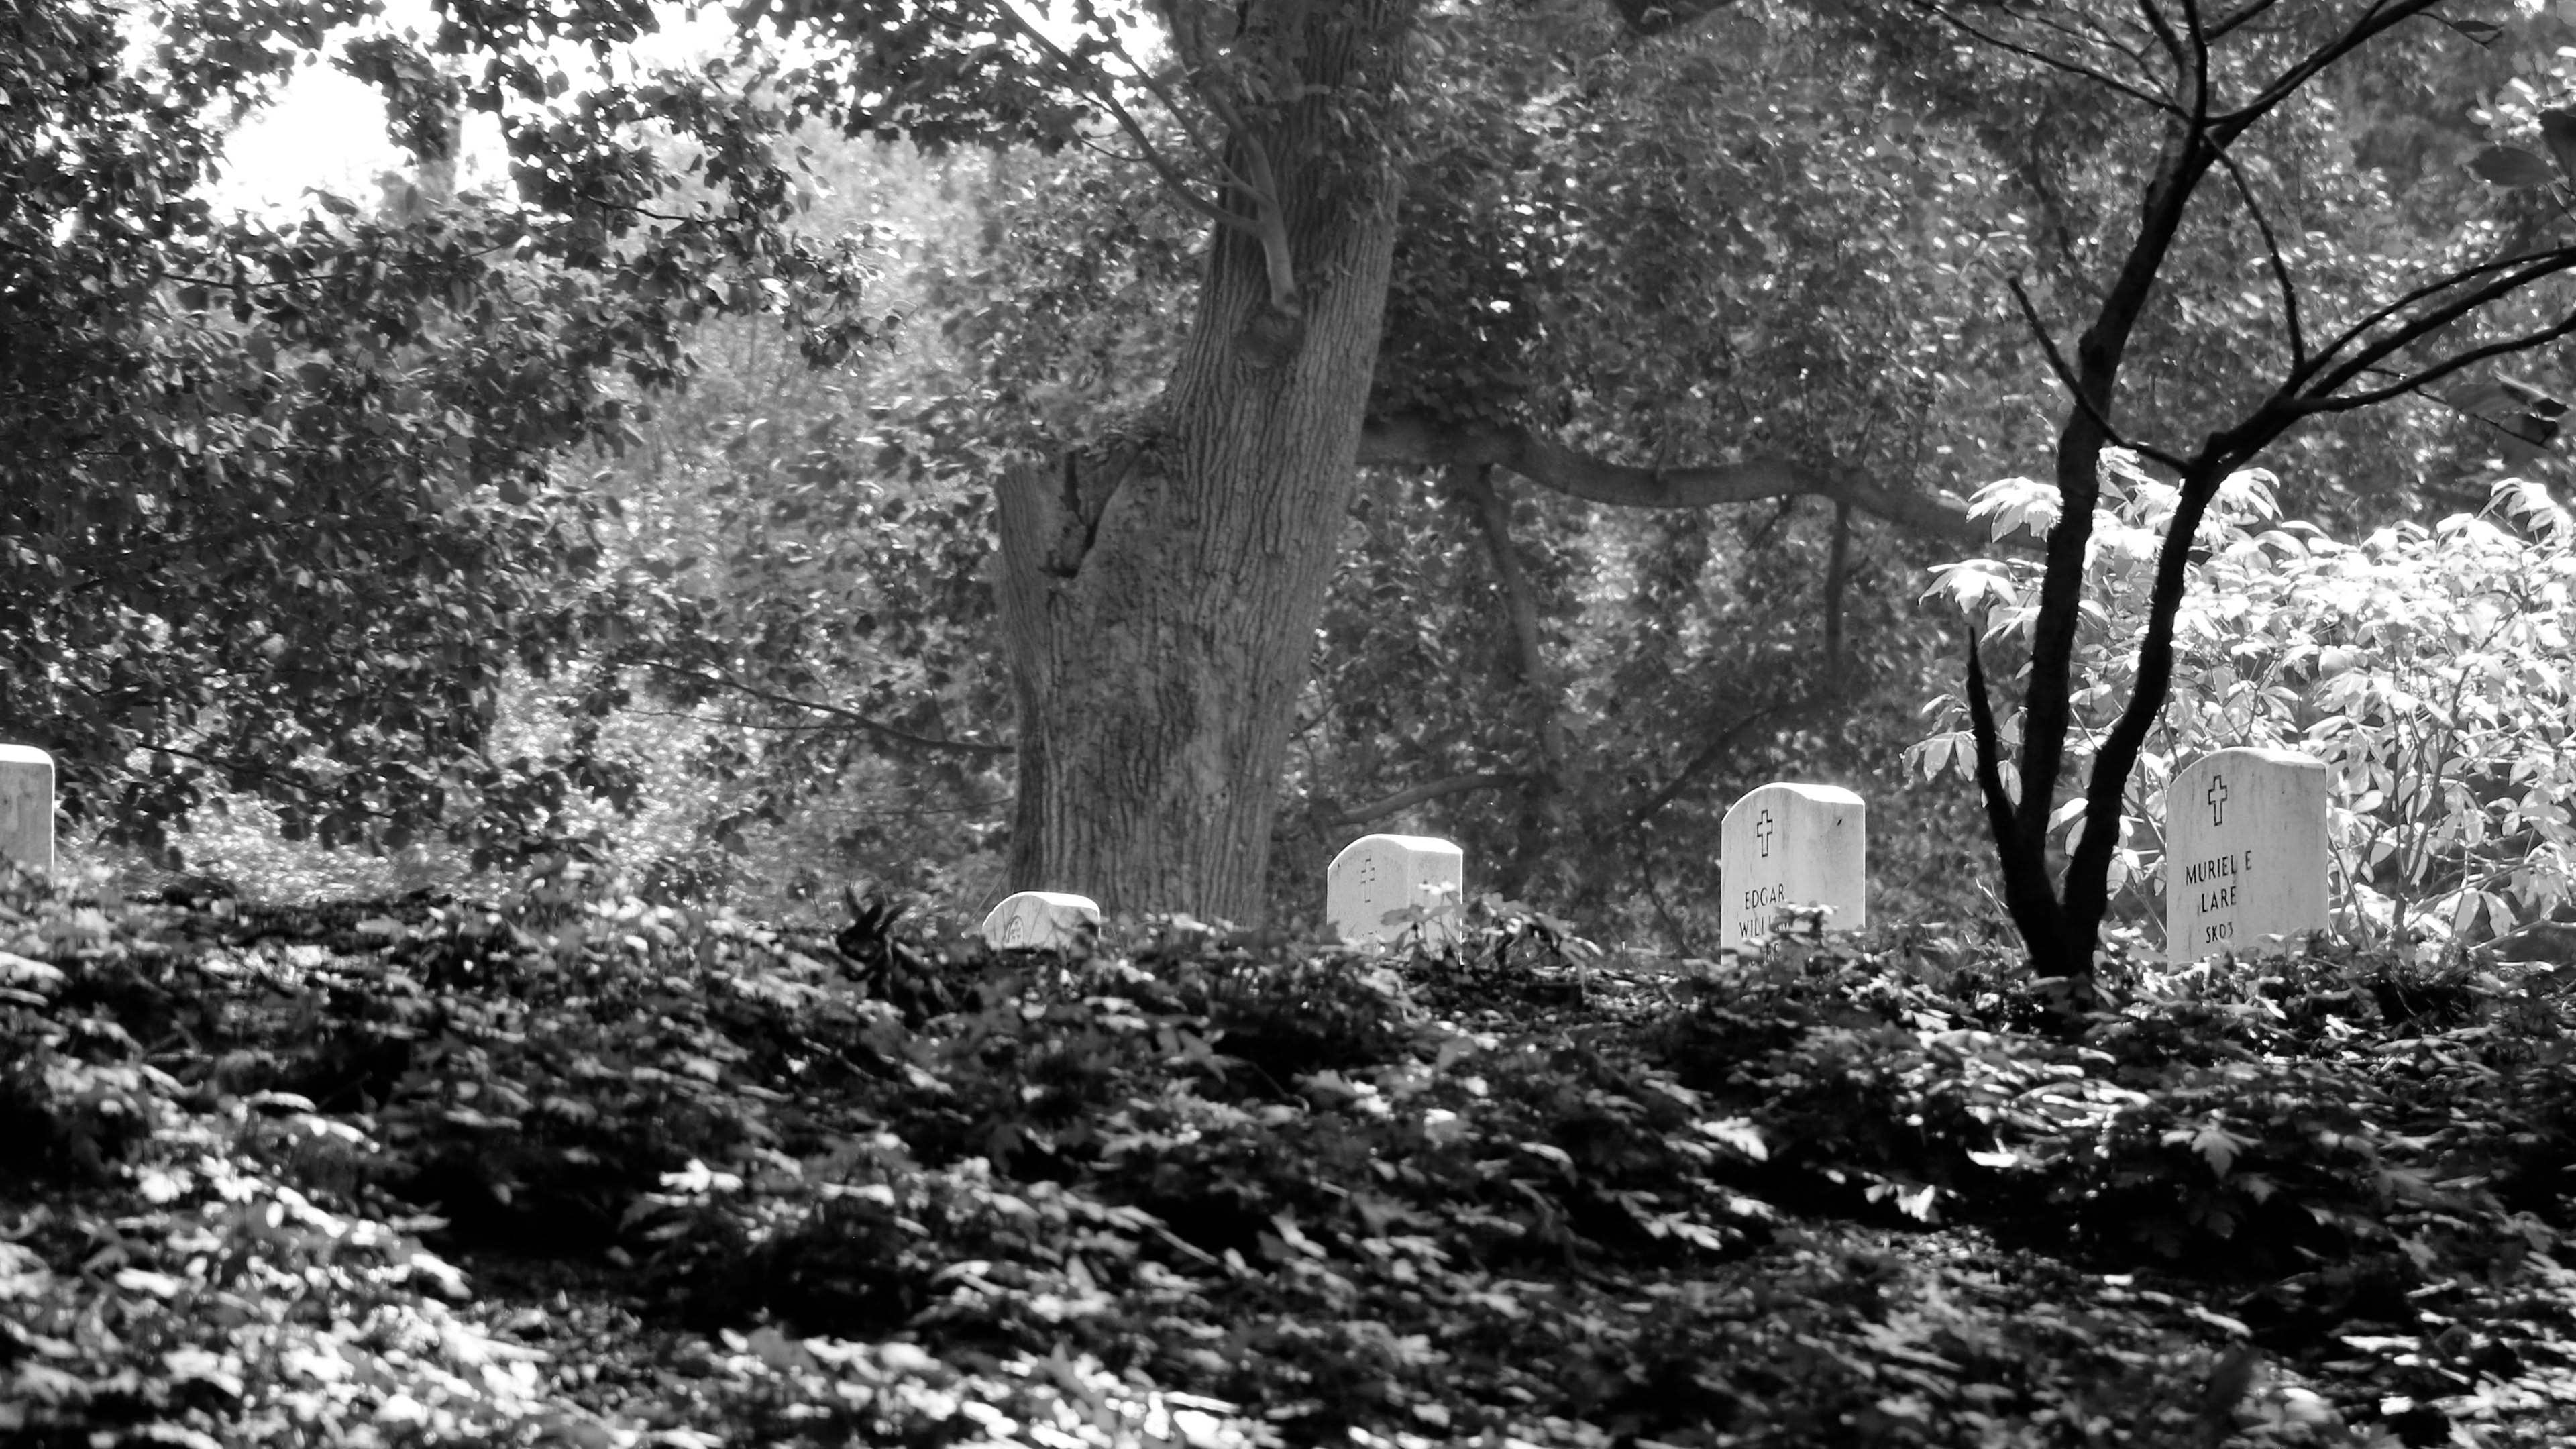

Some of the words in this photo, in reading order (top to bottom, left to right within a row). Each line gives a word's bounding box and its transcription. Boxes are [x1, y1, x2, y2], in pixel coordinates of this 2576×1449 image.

[2186, 854, 2237, 885] MURIEL
[2245, 850, 2251, 871] E
[1745, 883, 1784, 910] EDGAR
[2202, 885, 2237, 913] LARE
